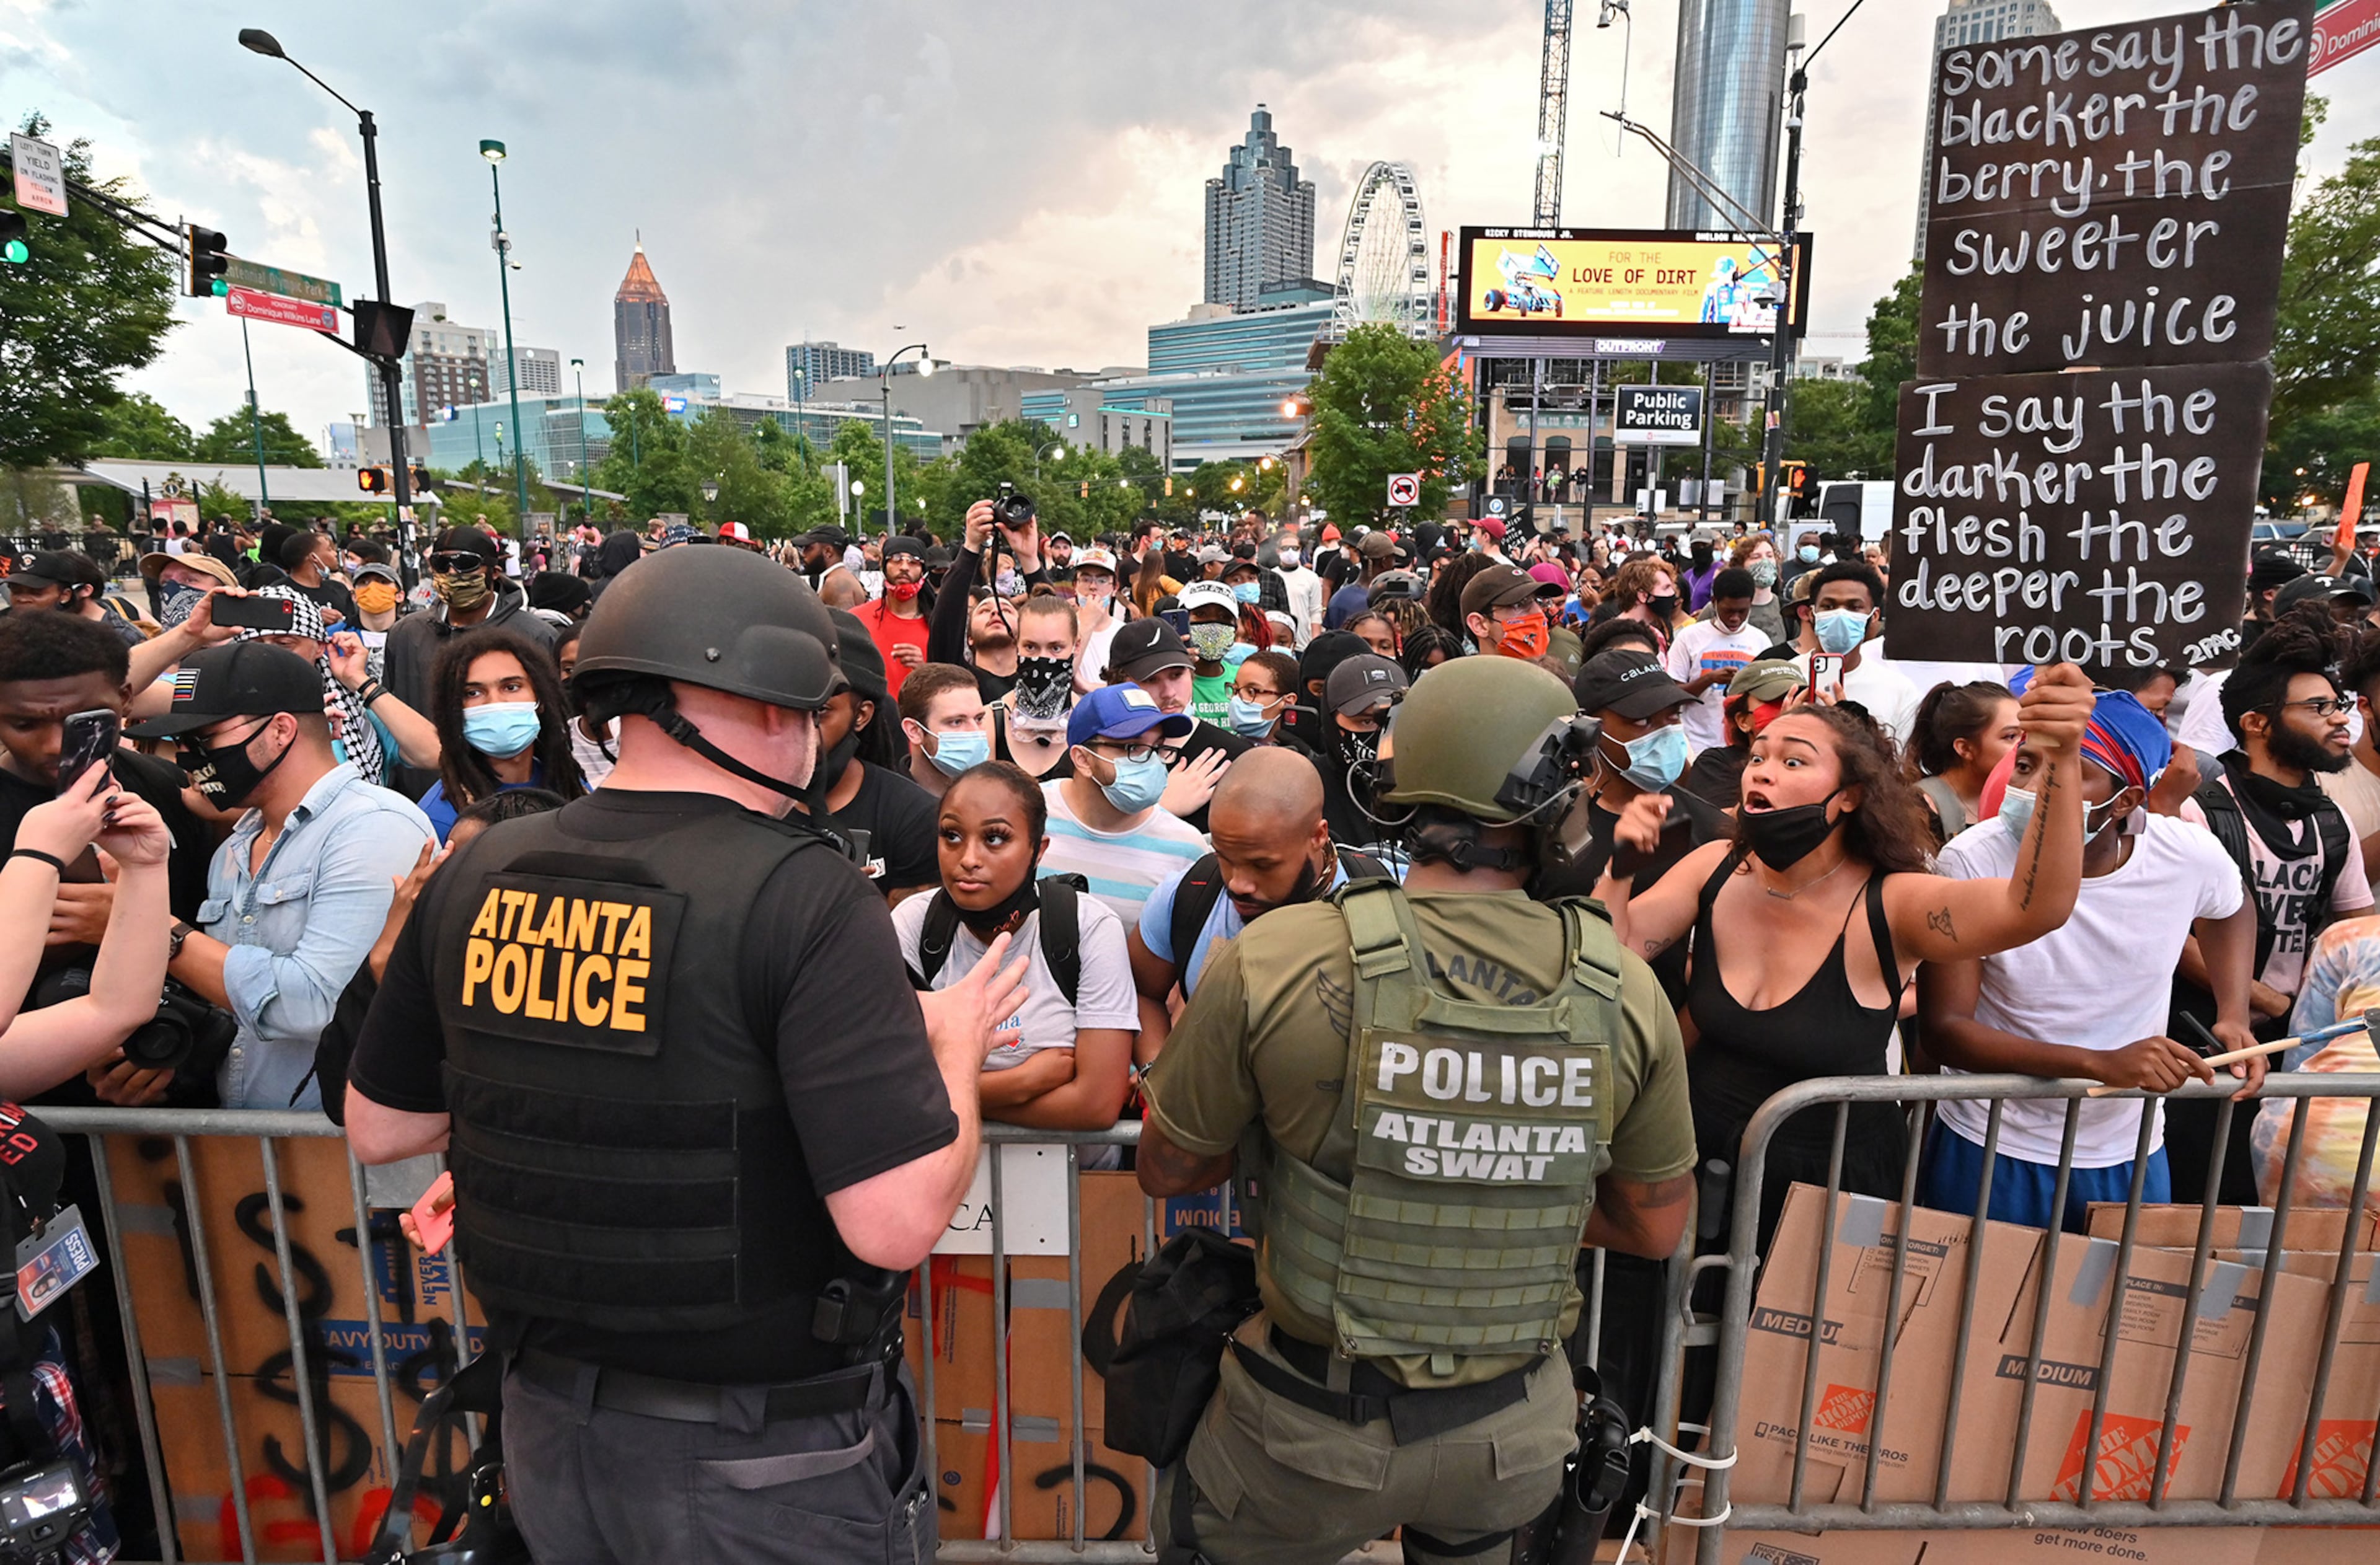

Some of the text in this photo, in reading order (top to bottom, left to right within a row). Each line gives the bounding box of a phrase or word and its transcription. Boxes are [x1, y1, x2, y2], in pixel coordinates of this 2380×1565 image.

[2327, 12, 2380, 56] Domini
[1943, 10, 2304, 96] some say the
[1941, 84, 2259, 148] blacker the
[25, 155, 50, 170] YIELD
[2114, 149, 2231, 201] the
[1484, 229, 1509, 238] RICKY
[1609, 252, 1662, 263] FOR THE
[1573, 268, 1696, 284] LOVE OF DIRT
[306, 281, 322, 296] Park
[1636, 288, 1680, 296] DOCUMENTARY
[247, 304, 322, 325] Dominique Wilkins Lane
[1936, 286, 2236, 361] the juice
[1596, 340, 1662, 353] OUTFRONT
[1633, 392, 1686, 409] Public
[1626, 410, 1693, 430] Parking
[1912, 379, 2216, 454] I say the
[1902, 443, 2218, 508] darker the
[1900, 506, 2193, 563] flesh the
[1898, 557, 2206, 624] deeper the
[470, 888, 651, 959] ATLANTA
[462, 937, 651, 1032] POLICE
[1377, 1041, 1593, 1107] POLICE
[1372, 1111, 1586, 1153] ATLANTA
[1404, 1147, 1554, 1181] SWAT
[65, 1233, 91, 1271] PRESS
[418, 1256, 438, 1306] NEVER
[2126, 1280, 2151, 1290] PLACE
[2122, 1307, 2143, 1316] FAMILY
[2125, 1300, 2154, 1309] BEDROOM
[1761, 1312, 1838, 1340] MEDU
[2137, 1324, 2155, 1332] ROOM
[2195, 1327, 2219, 1336] GARAGE
[2198, 1319, 2229, 1329] BASEMENT
[323, 1331, 372, 1348] AVY
[2006, 1360, 2092, 1386] MDIUM
[1817, 1391, 1876, 1427] HOME
[1829, 1391, 1851, 1406] THE
[1835, 1408, 1869, 1430] DEPOT
[1770, 1425, 1798, 1439] PAC
[1809, 1434, 1841, 1447] LIKE
[1844, 1440, 1870, 1454] THE
[2094, 1527, 2138, 1543] doers
[1757, 1546, 1777, 1555] MADE
[2034, 1533, 2148, 1562] get more done.
